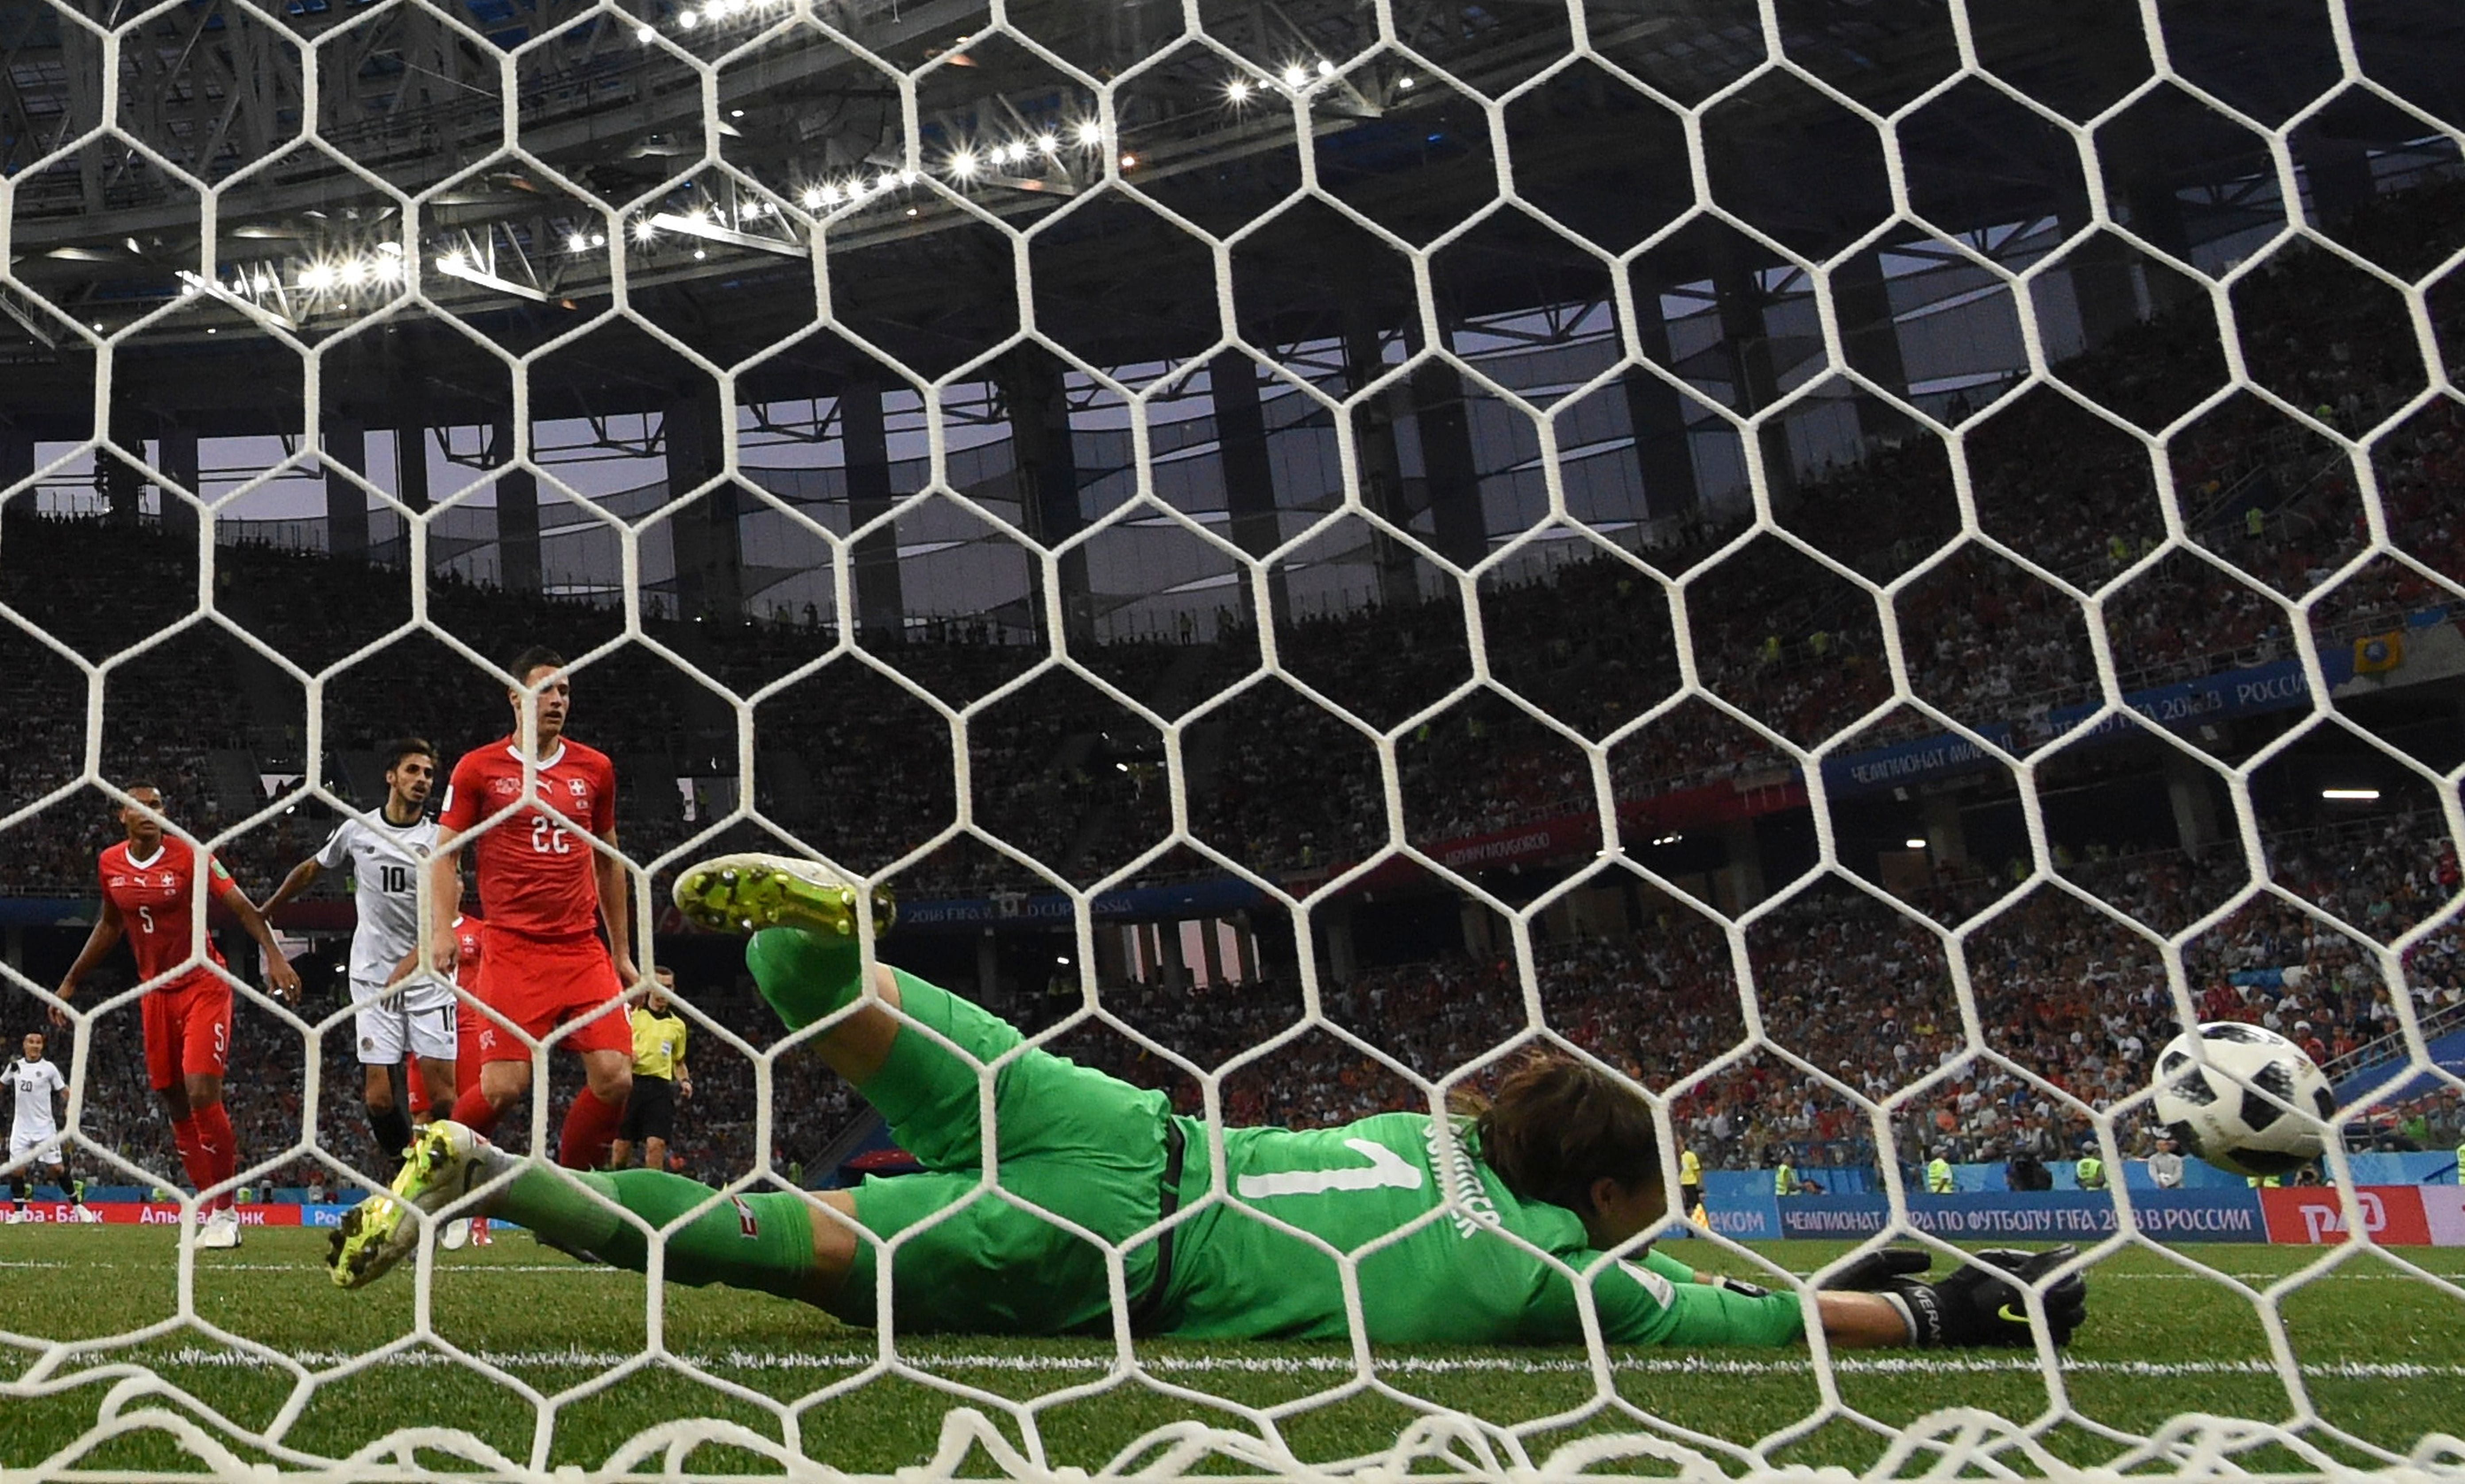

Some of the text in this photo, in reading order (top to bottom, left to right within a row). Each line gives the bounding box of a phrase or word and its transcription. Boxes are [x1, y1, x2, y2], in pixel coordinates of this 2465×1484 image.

[532, 815, 569, 853] 22
[380, 865, 406, 893] 10
[139, 906, 154, 934] 5
[214, 1023, 224, 1052] 5
[20, 1079, 32, 1092] 20
[1237, 1138, 1422, 1198] 1
[1785, 1211, 1880, 1231] ЧЕМПИОНАТ
[1937, 1210, 1964, 1230] ПО
[1967, 1209, 2052, 1231] ФУТБОЛУ
[2055, 1209, 2097, 1231] FIFA
[2146, 1209, 2162, 1230] В
[2164, 1209, 2252, 1230] РОССИИ
